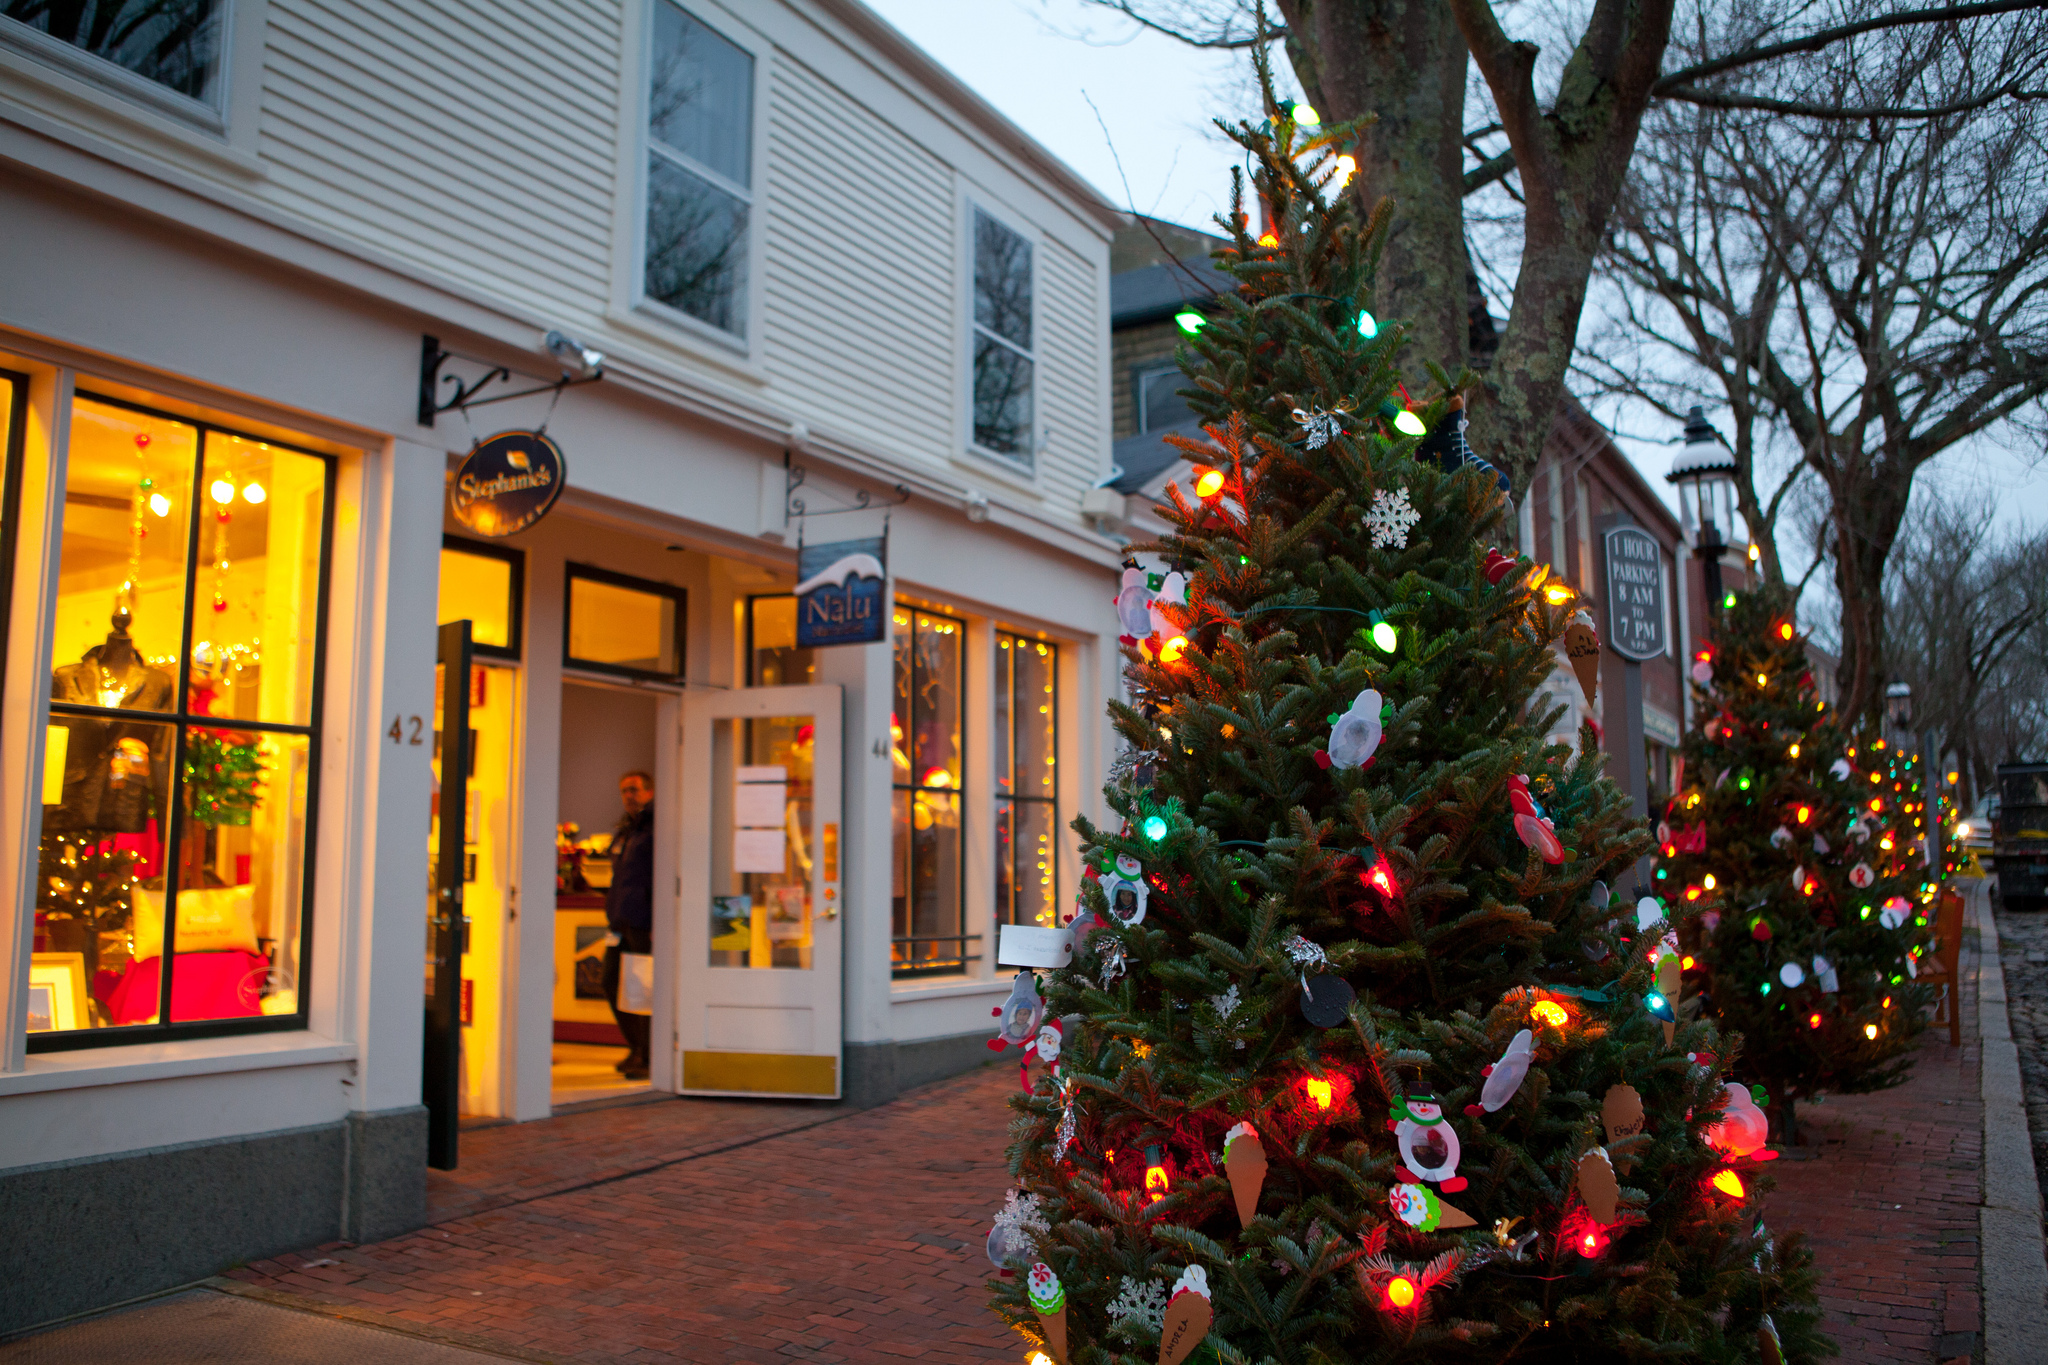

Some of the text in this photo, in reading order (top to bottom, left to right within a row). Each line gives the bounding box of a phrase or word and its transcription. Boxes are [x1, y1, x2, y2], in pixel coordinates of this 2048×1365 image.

[459, 464, 552, 507] Stephanie's
[1623, 536, 1654, 562] HOUR
[1613, 561, 1657, 587] PARKING
[807, 584, 871, 624] Nalu
[1618, 584, 1653, 606] 8 AM
[1632, 607, 1644, 619] TO
[1620, 616, 1655, 641] 7 PM
[387, 713, 424, 746] 42
[872, 737, 888, 760] 44
[1165, 1318, 1189, 1358] ANDREA
